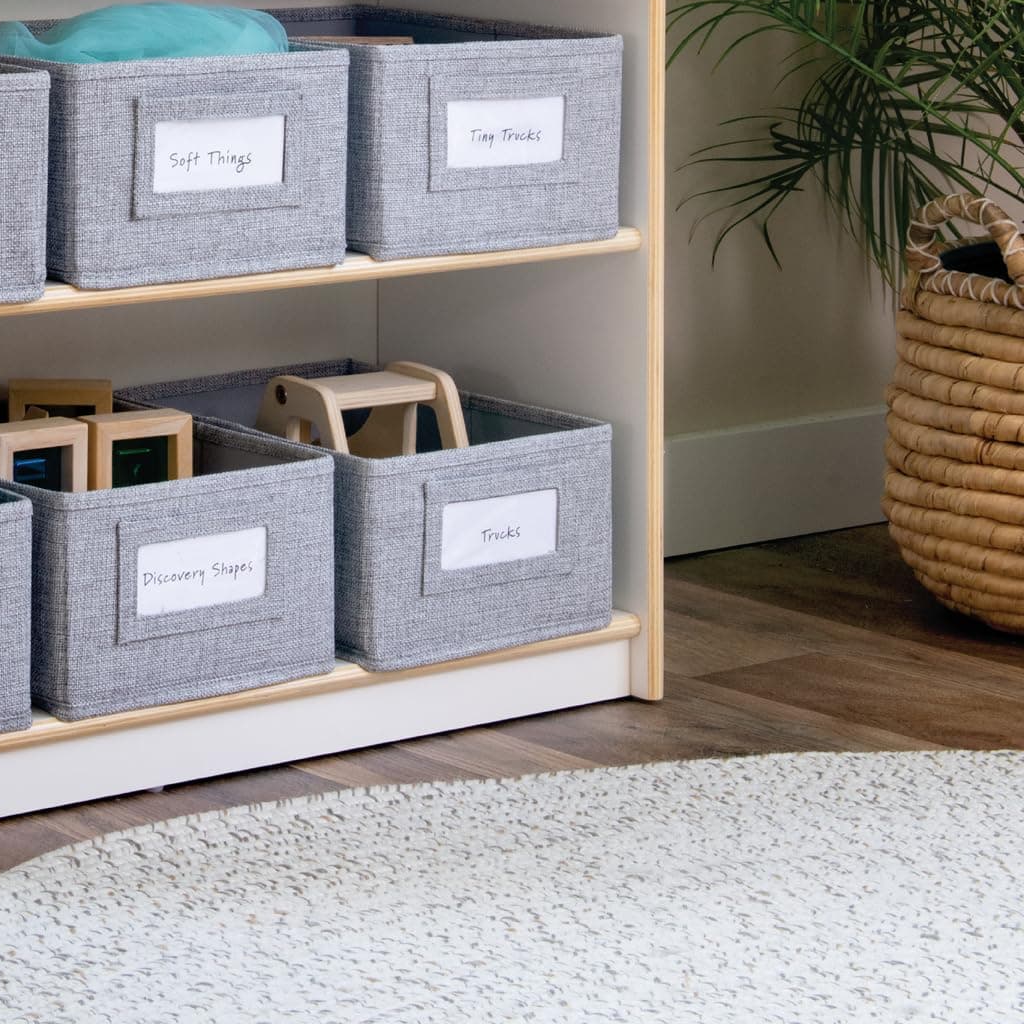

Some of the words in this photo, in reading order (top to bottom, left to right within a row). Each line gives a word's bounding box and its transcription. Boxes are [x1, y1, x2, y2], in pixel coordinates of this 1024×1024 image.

[469, 128, 495, 149] Tiny
[500, 127, 542, 142] Trucks
[169, 151, 201, 172] Soft
[207, 150, 252, 173] Things
[480, 526, 521, 543] Trucks
[143, 569, 205, 587] Discovery
[211, 560, 254, 581] Shapes
